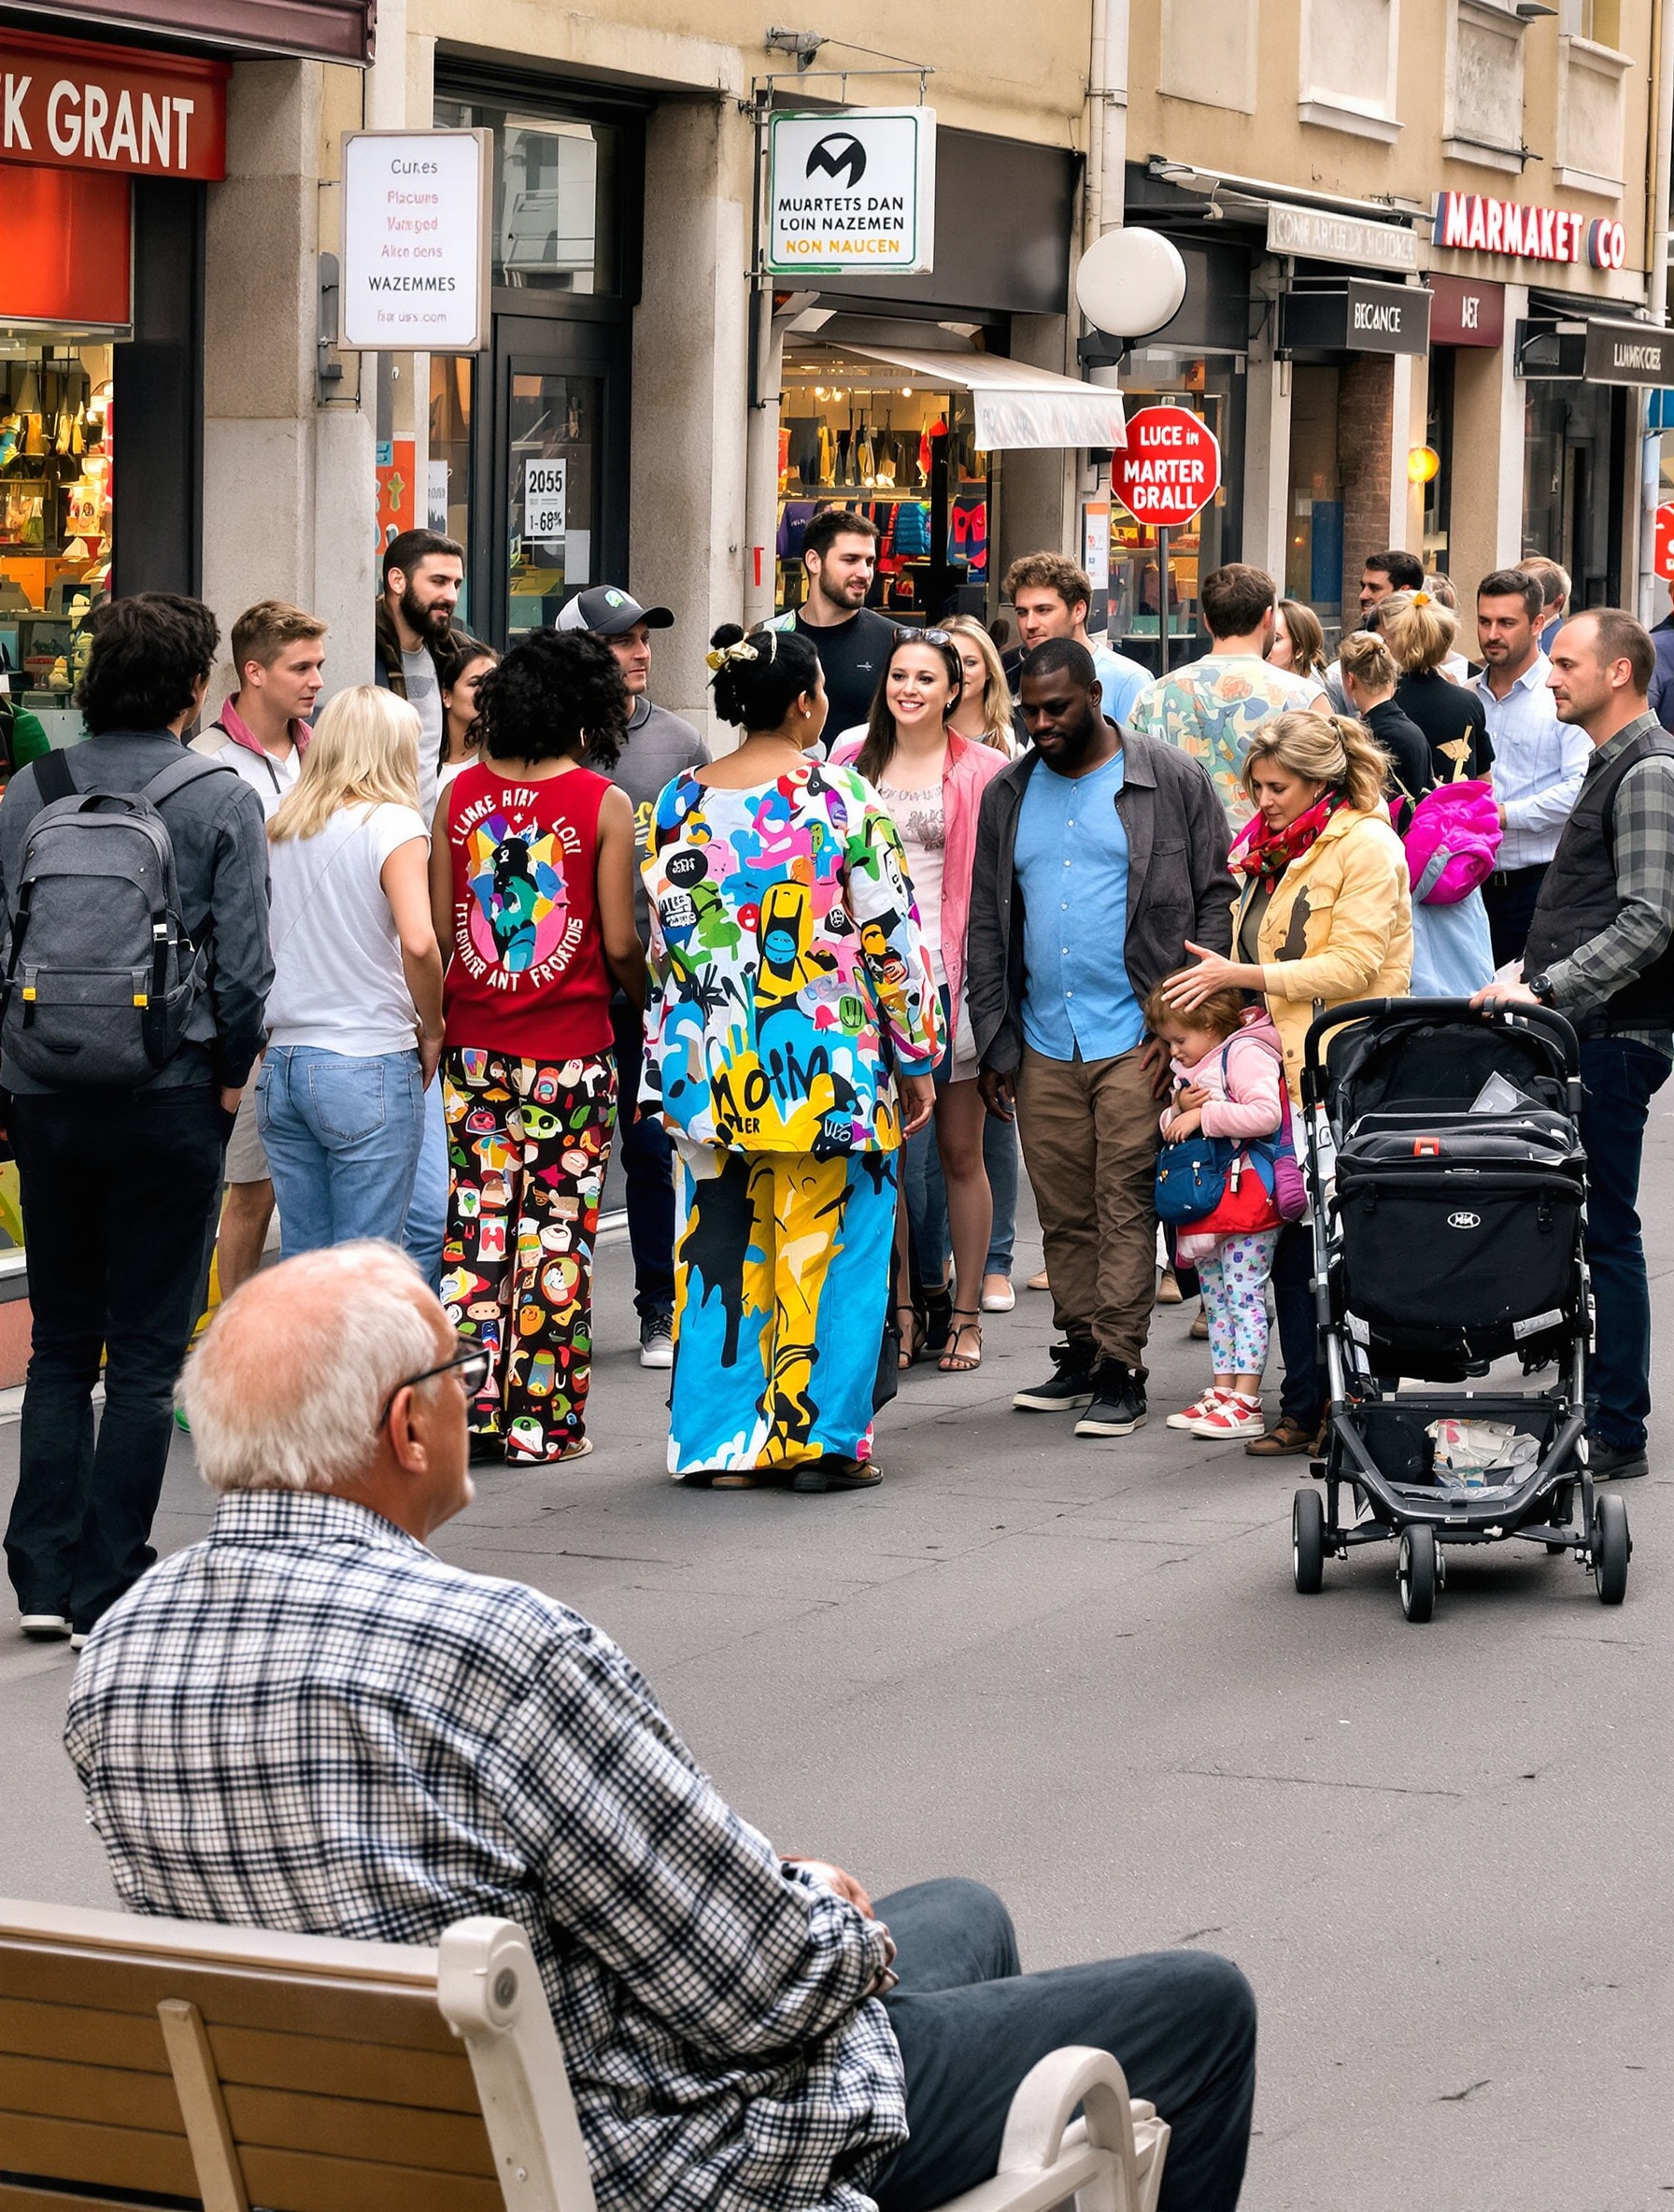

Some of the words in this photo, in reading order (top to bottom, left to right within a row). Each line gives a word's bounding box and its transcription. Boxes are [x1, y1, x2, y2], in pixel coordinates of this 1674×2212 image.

[47, 79, 194, 170] GRANT
[778, 197, 862, 212] MUARTETS
[867, 196, 903, 211] DAN
[780, 218, 816, 231] LOIN
[822, 217, 904, 231] NAZEMEN
[1443, 191, 1584, 263] MARMAKET
[1594, 218, 1627, 270] CO
[786, 239, 822, 254] NON
[829, 239, 900, 253] NAUCEN
[368, 276, 456, 291] WAZEMMES
[1140, 425, 1184, 446] LUCE
[529, 470, 563, 493] 2055
[1124, 459, 1205, 483] MARTER
[487, 969, 520, 991] ANT
